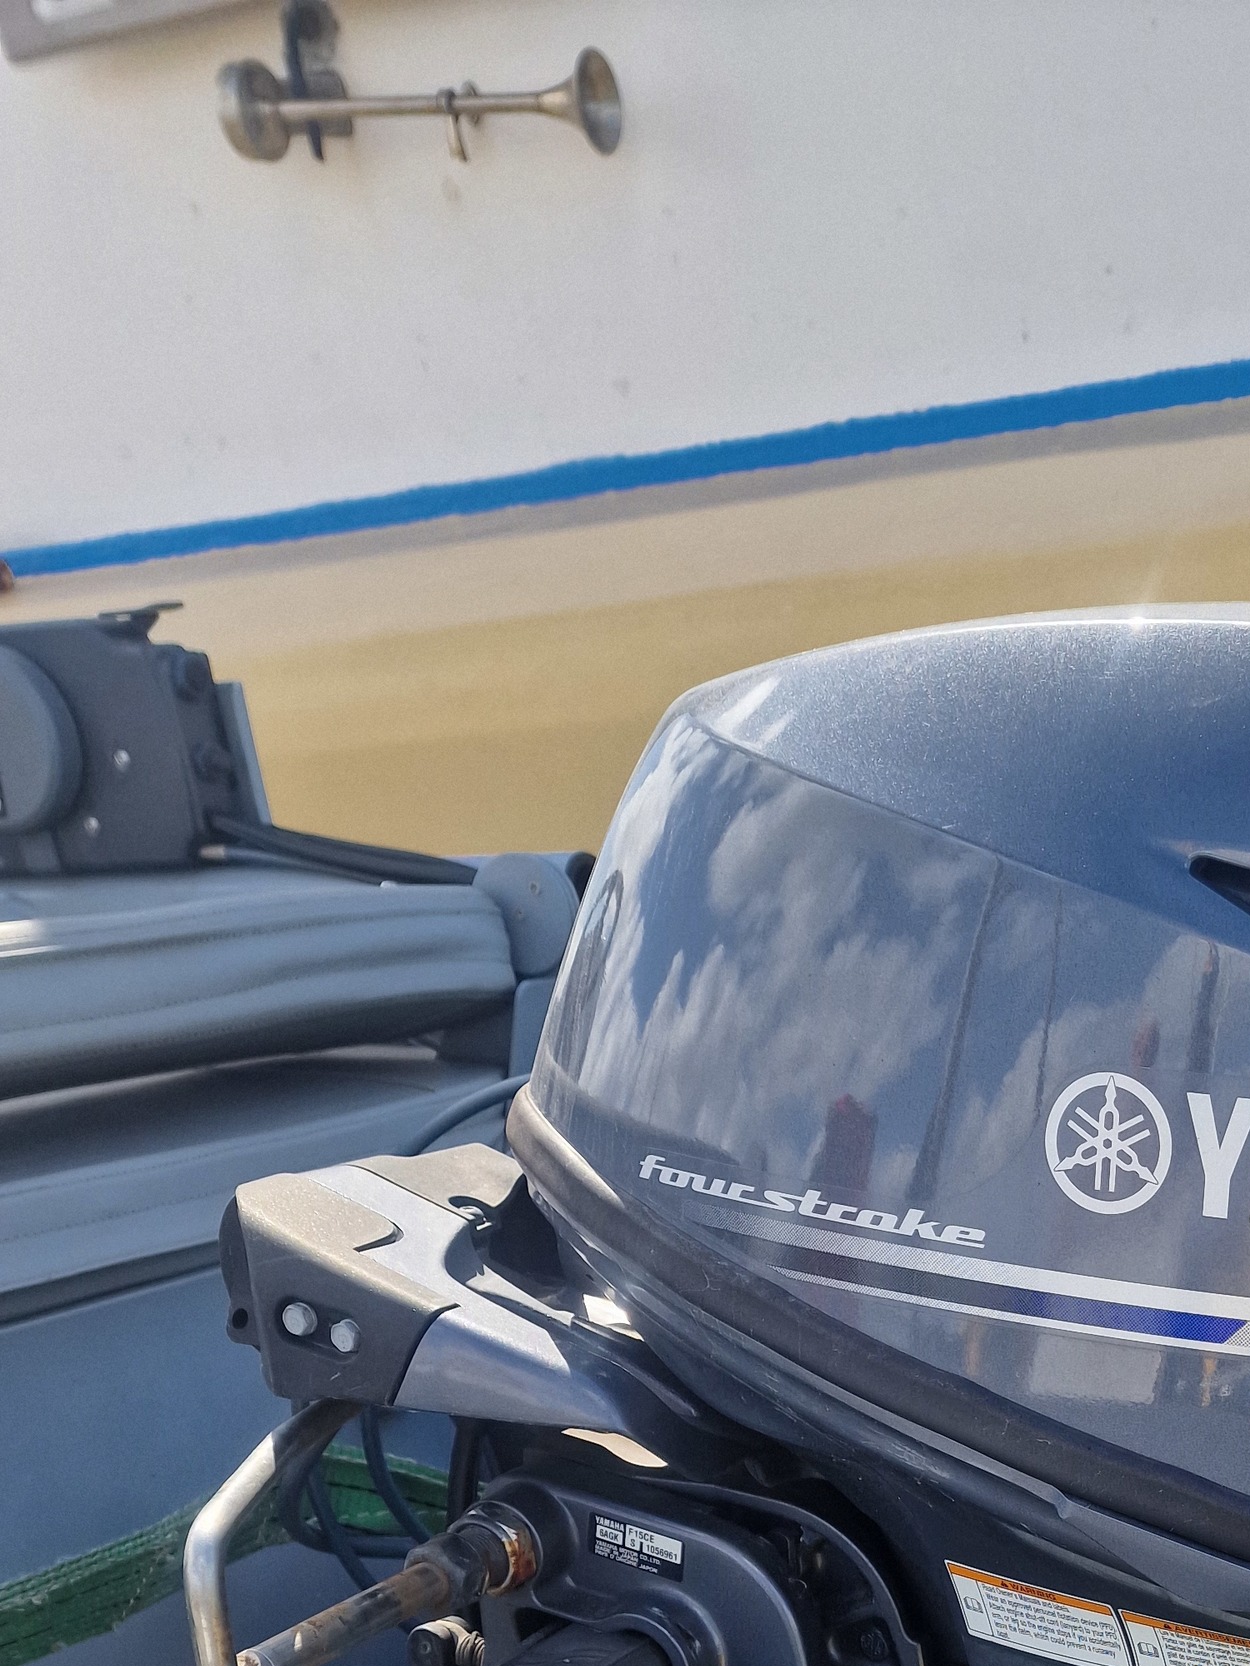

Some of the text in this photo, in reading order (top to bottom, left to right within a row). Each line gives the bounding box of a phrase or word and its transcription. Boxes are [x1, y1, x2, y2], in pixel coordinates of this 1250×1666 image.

[596, 1516, 624, 1532] YAMAHA
[600, 1529, 618, 1542] 6AGK
[629, 1528, 654, 1543] F15CE
[631, 1539, 677, 1561] S 1056961
[1009, 1582, 1056, 1601] WARNING
